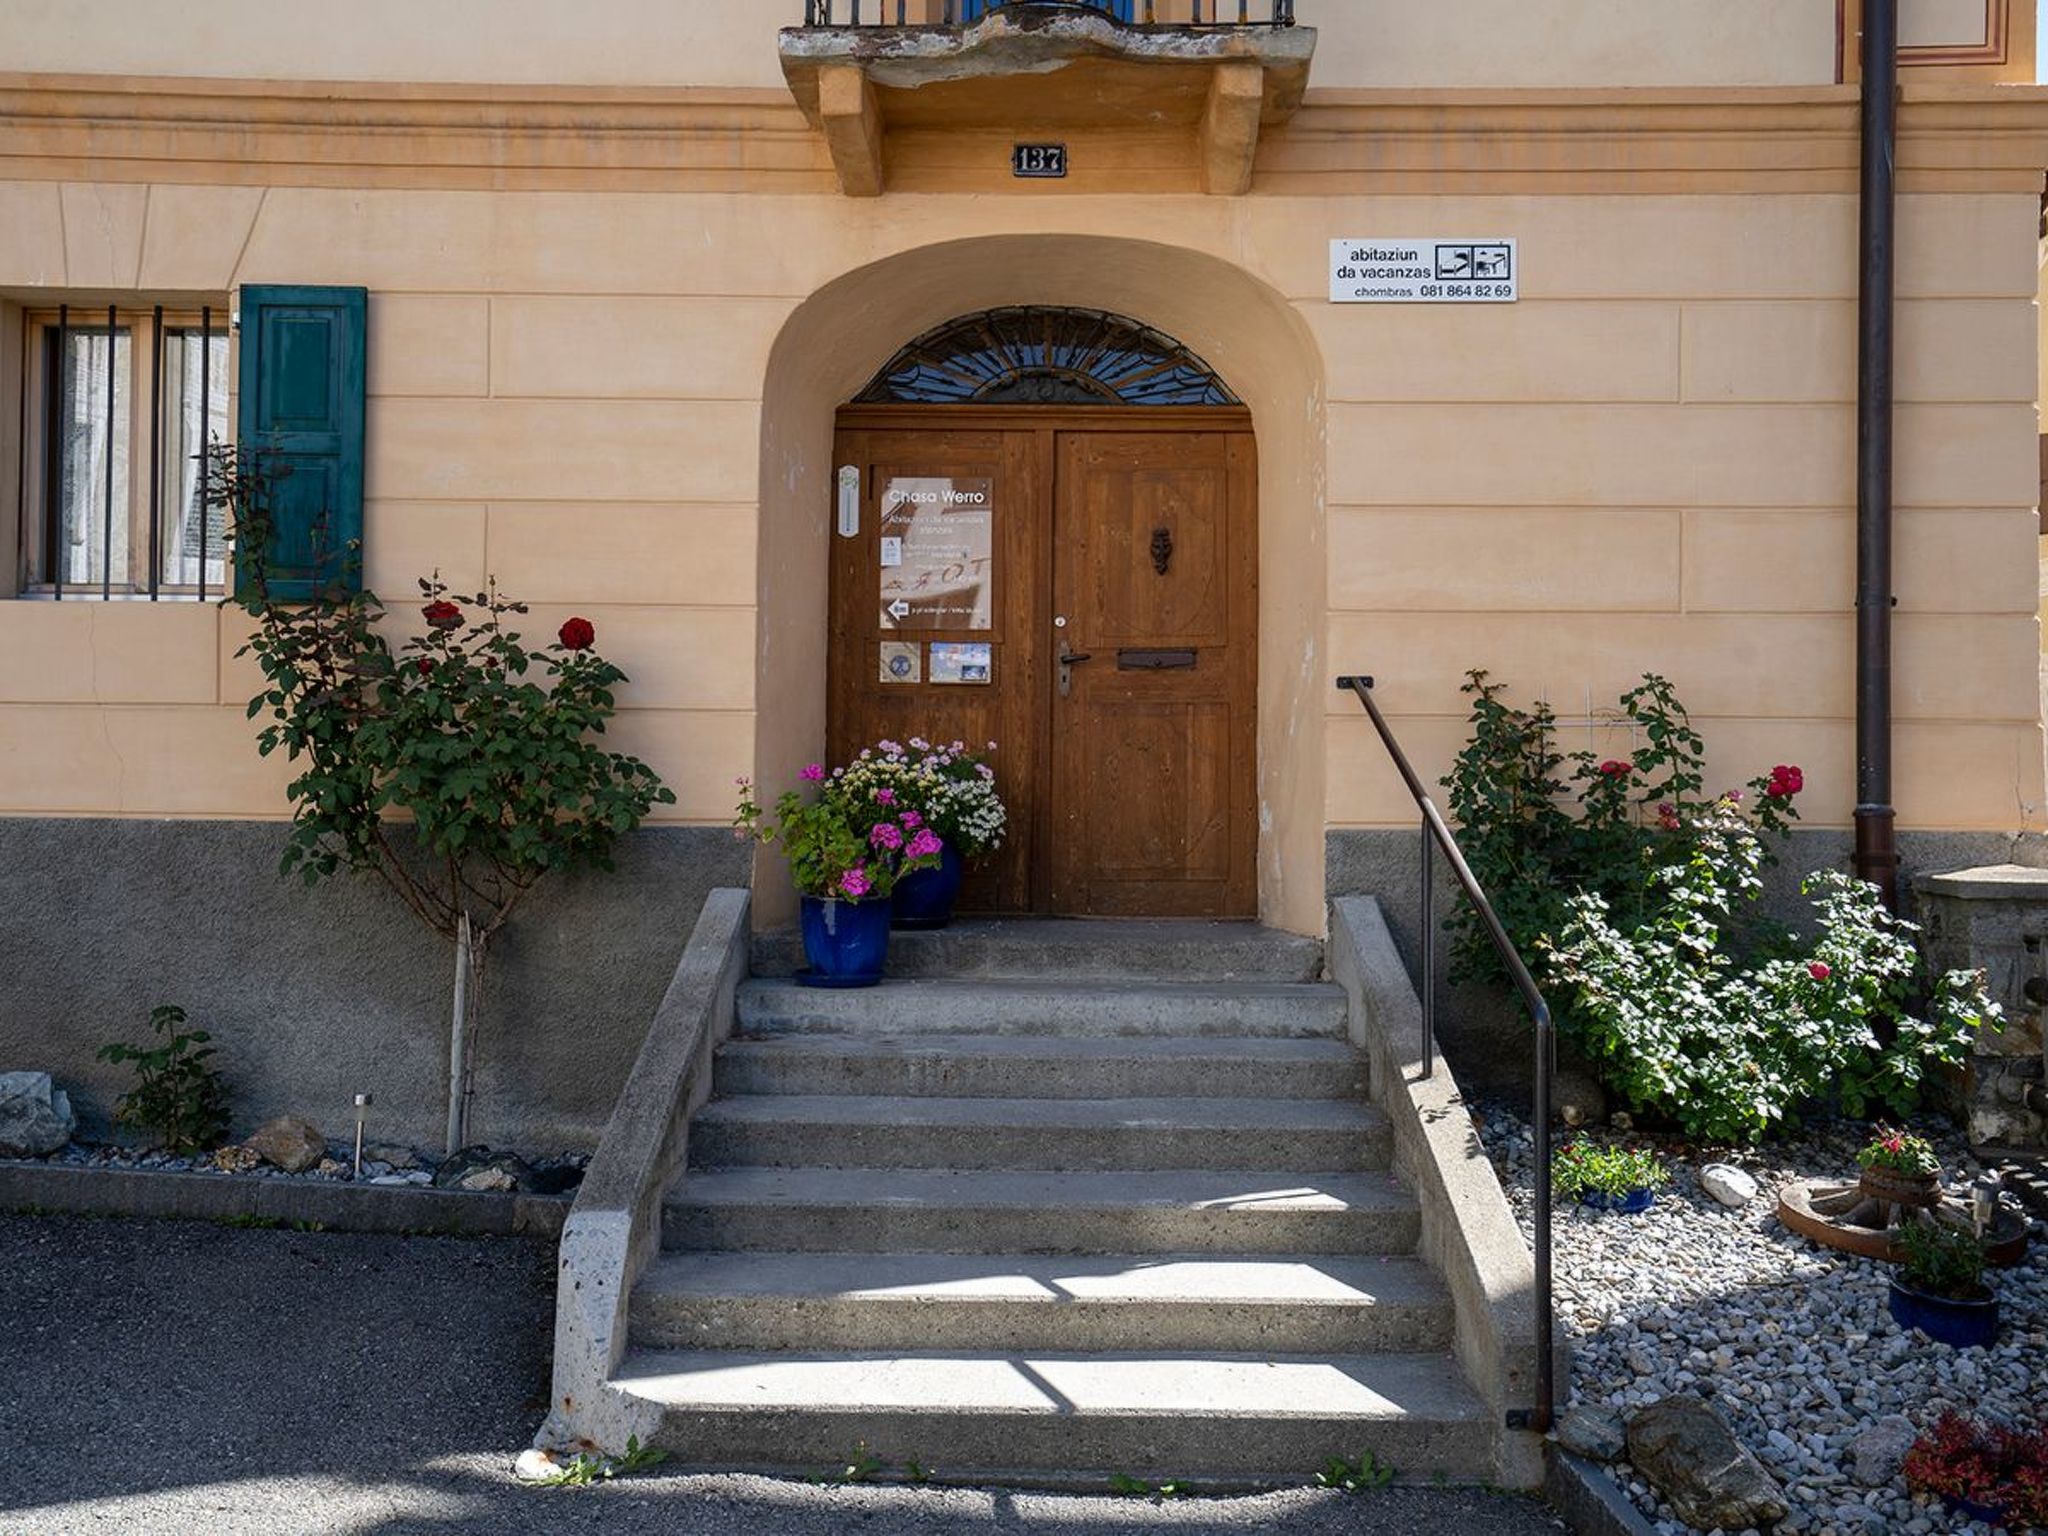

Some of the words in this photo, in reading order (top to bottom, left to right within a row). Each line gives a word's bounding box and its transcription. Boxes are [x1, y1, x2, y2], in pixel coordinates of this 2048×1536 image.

[1020, 147, 1060, 170] 137
[1350, 248, 1418, 262] abitaziun
[1337, 266, 1356, 279] da
[1360, 268, 1431, 279] vacanzas
[1354, 286, 1413, 297] chombras
[1420, 285, 1443, 297] 081
[1446, 285, 1472, 297] 864
[1474, 285, 1491, 297] 82
[1494, 285, 1512, 297] 69
[889, 489, 937, 503] Chasa
[941, 490, 985, 503] Werro
